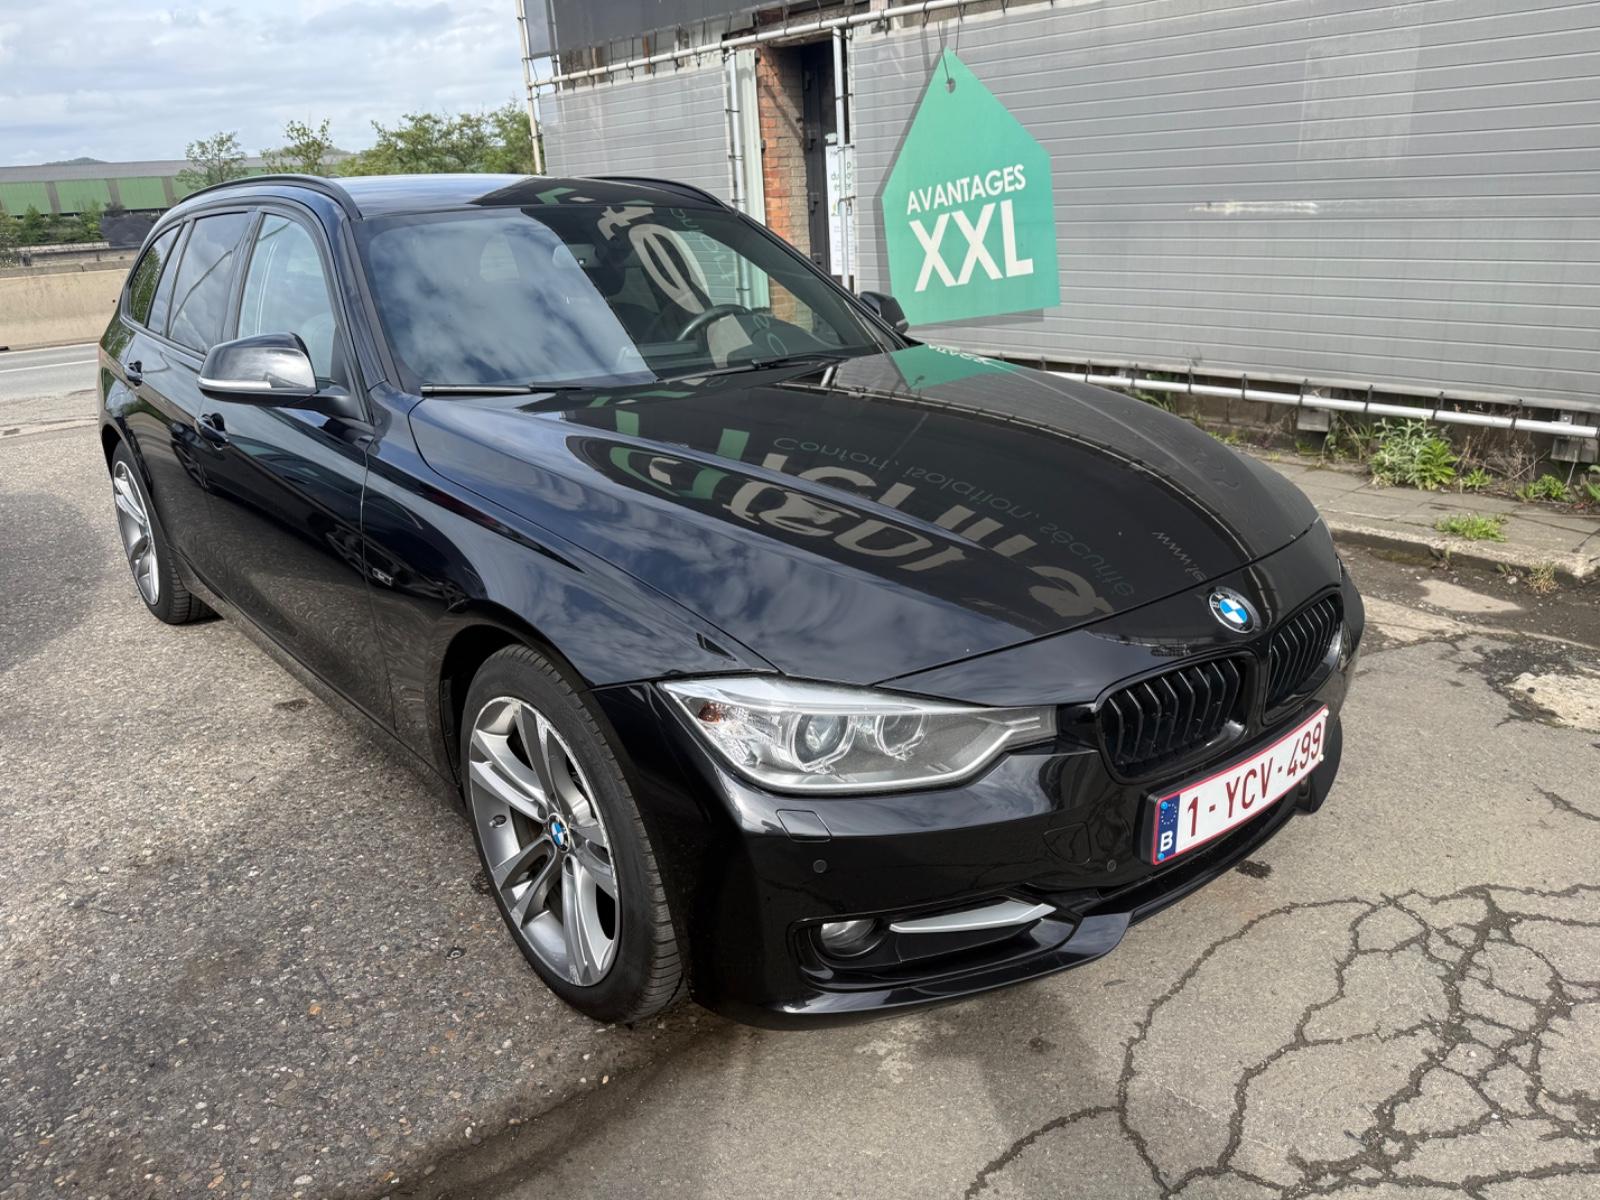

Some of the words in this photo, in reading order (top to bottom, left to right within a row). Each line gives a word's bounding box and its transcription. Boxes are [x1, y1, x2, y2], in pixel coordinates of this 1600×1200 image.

[906, 164, 1026, 215] AVANTAGES
[908, 199, 1034, 293] XXL
[1187, 721, 1323, 837] 1-YCV-499
[1160, 830, 1174, 851] B
